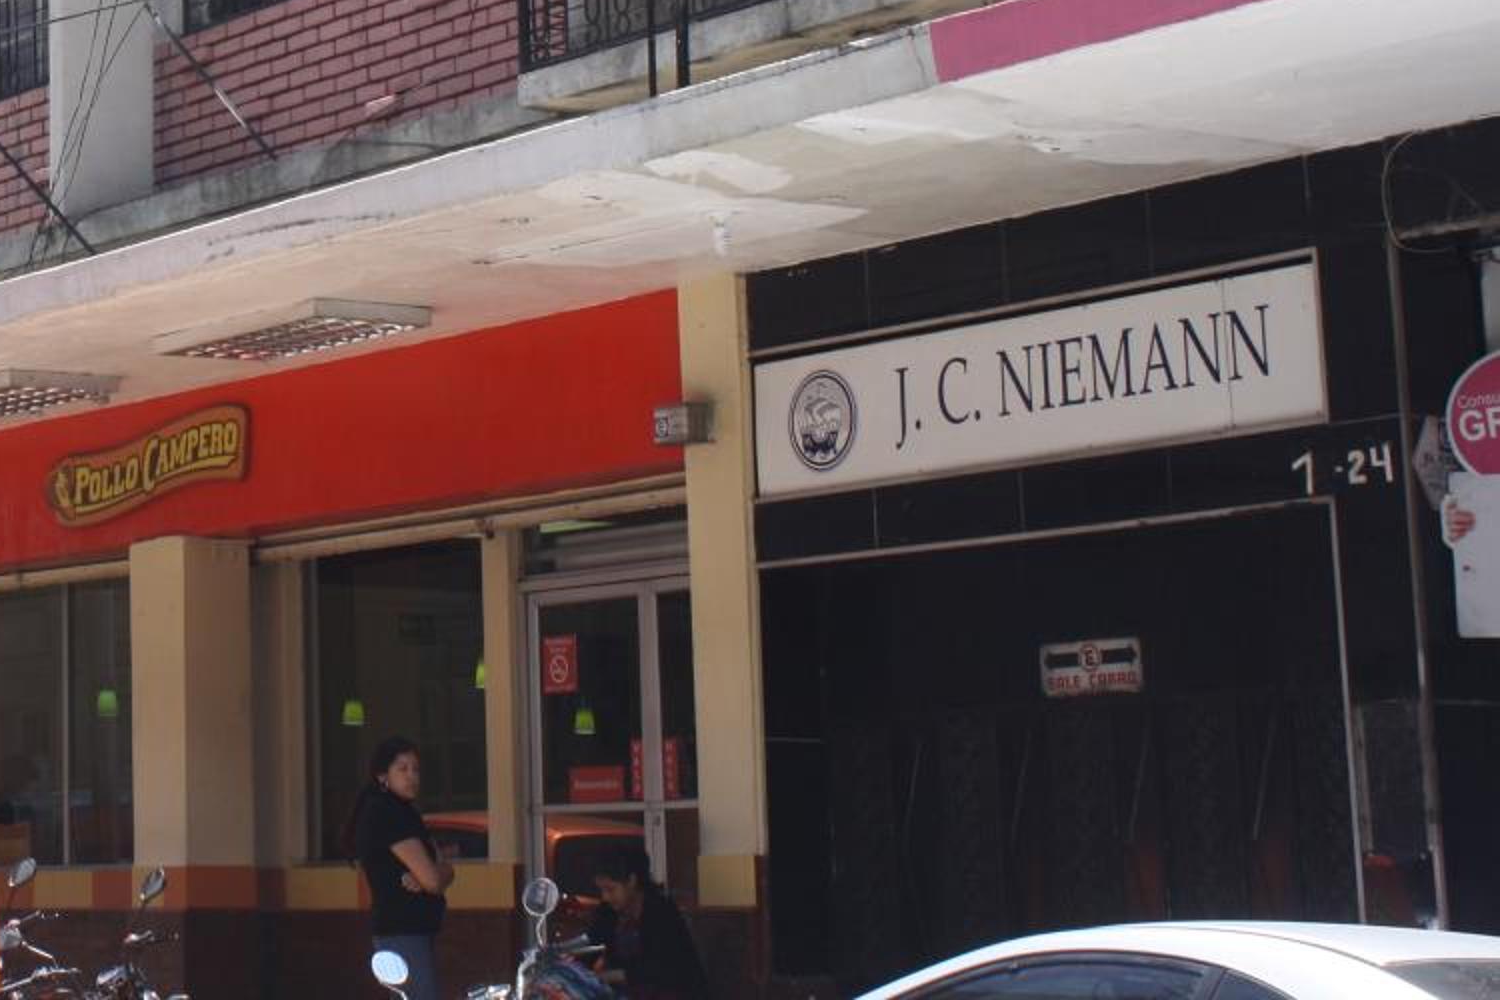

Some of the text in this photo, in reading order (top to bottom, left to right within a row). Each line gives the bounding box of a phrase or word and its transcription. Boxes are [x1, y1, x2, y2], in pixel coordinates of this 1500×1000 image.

[894, 303, 1271, 449] J. C. NIEMANN
[74, 420, 238, 506] POLLO CAMPERO
